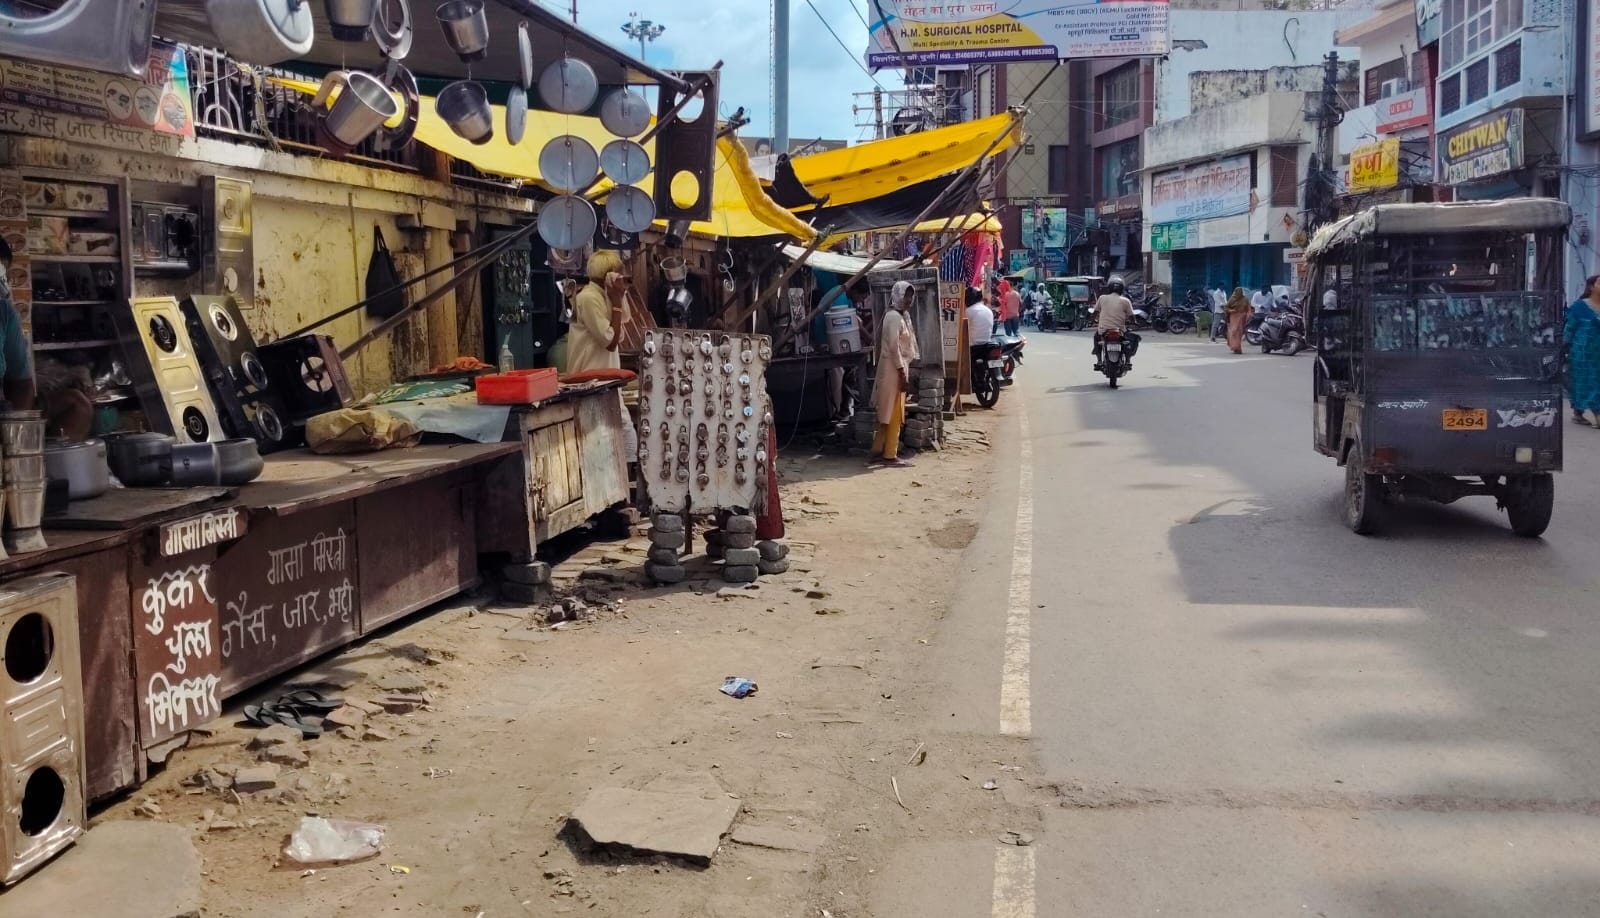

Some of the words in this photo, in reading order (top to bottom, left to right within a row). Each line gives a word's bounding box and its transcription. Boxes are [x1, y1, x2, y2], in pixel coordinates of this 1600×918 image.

[904, 5, 925, 16] सेहत
[930, 6, 943, 14] का
[947, 5, 964, 16] पूरा
[901, 28, 920, 38] H.M.
[924, 25, 972, 37] SURGICAL
[975, 22, 1022, 35] HOSPITAL
[929, 40, 957, 48] Speciality
[67, 119, 96, 139] जार
[1449, 117, 1508, 158] CHITWAN
[1353, 151, 1382, 175] उषा
[1447, 417, 1484, 427] 2494
[165, 519, 201, 556] गामा
[266, 540, 307, 585] गामा
[142, 564, 216, 635] कुकर
[145, 672, 222, 739] मिक्सर
